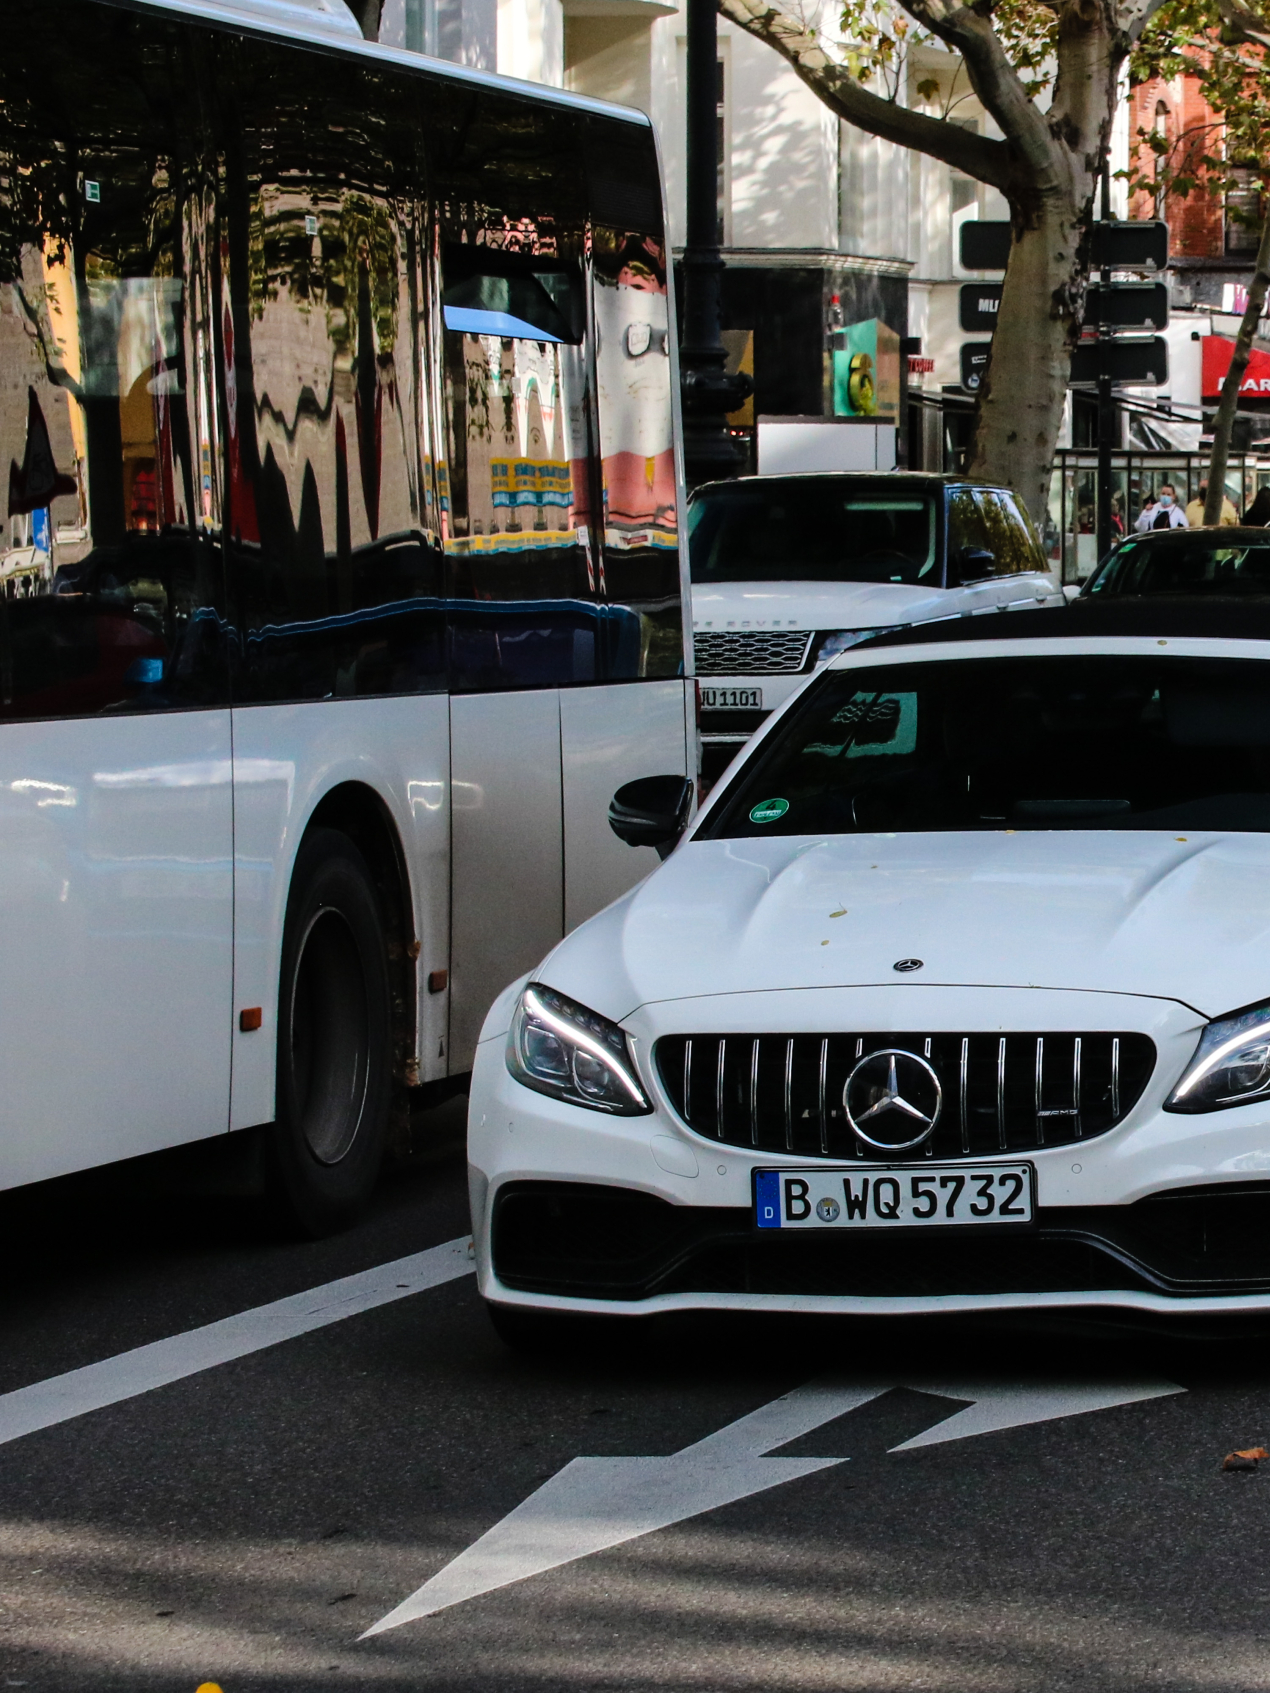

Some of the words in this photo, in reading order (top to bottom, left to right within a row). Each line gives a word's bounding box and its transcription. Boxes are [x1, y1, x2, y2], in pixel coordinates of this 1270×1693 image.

[719, 690, 759, 706] 1101
[785, 1178, 812, 1221] B
[843, 1177, 902, 1220] WQ
[911, 1172, 1026, 1218] 5732
[764, 1206, 774, 1219] D
